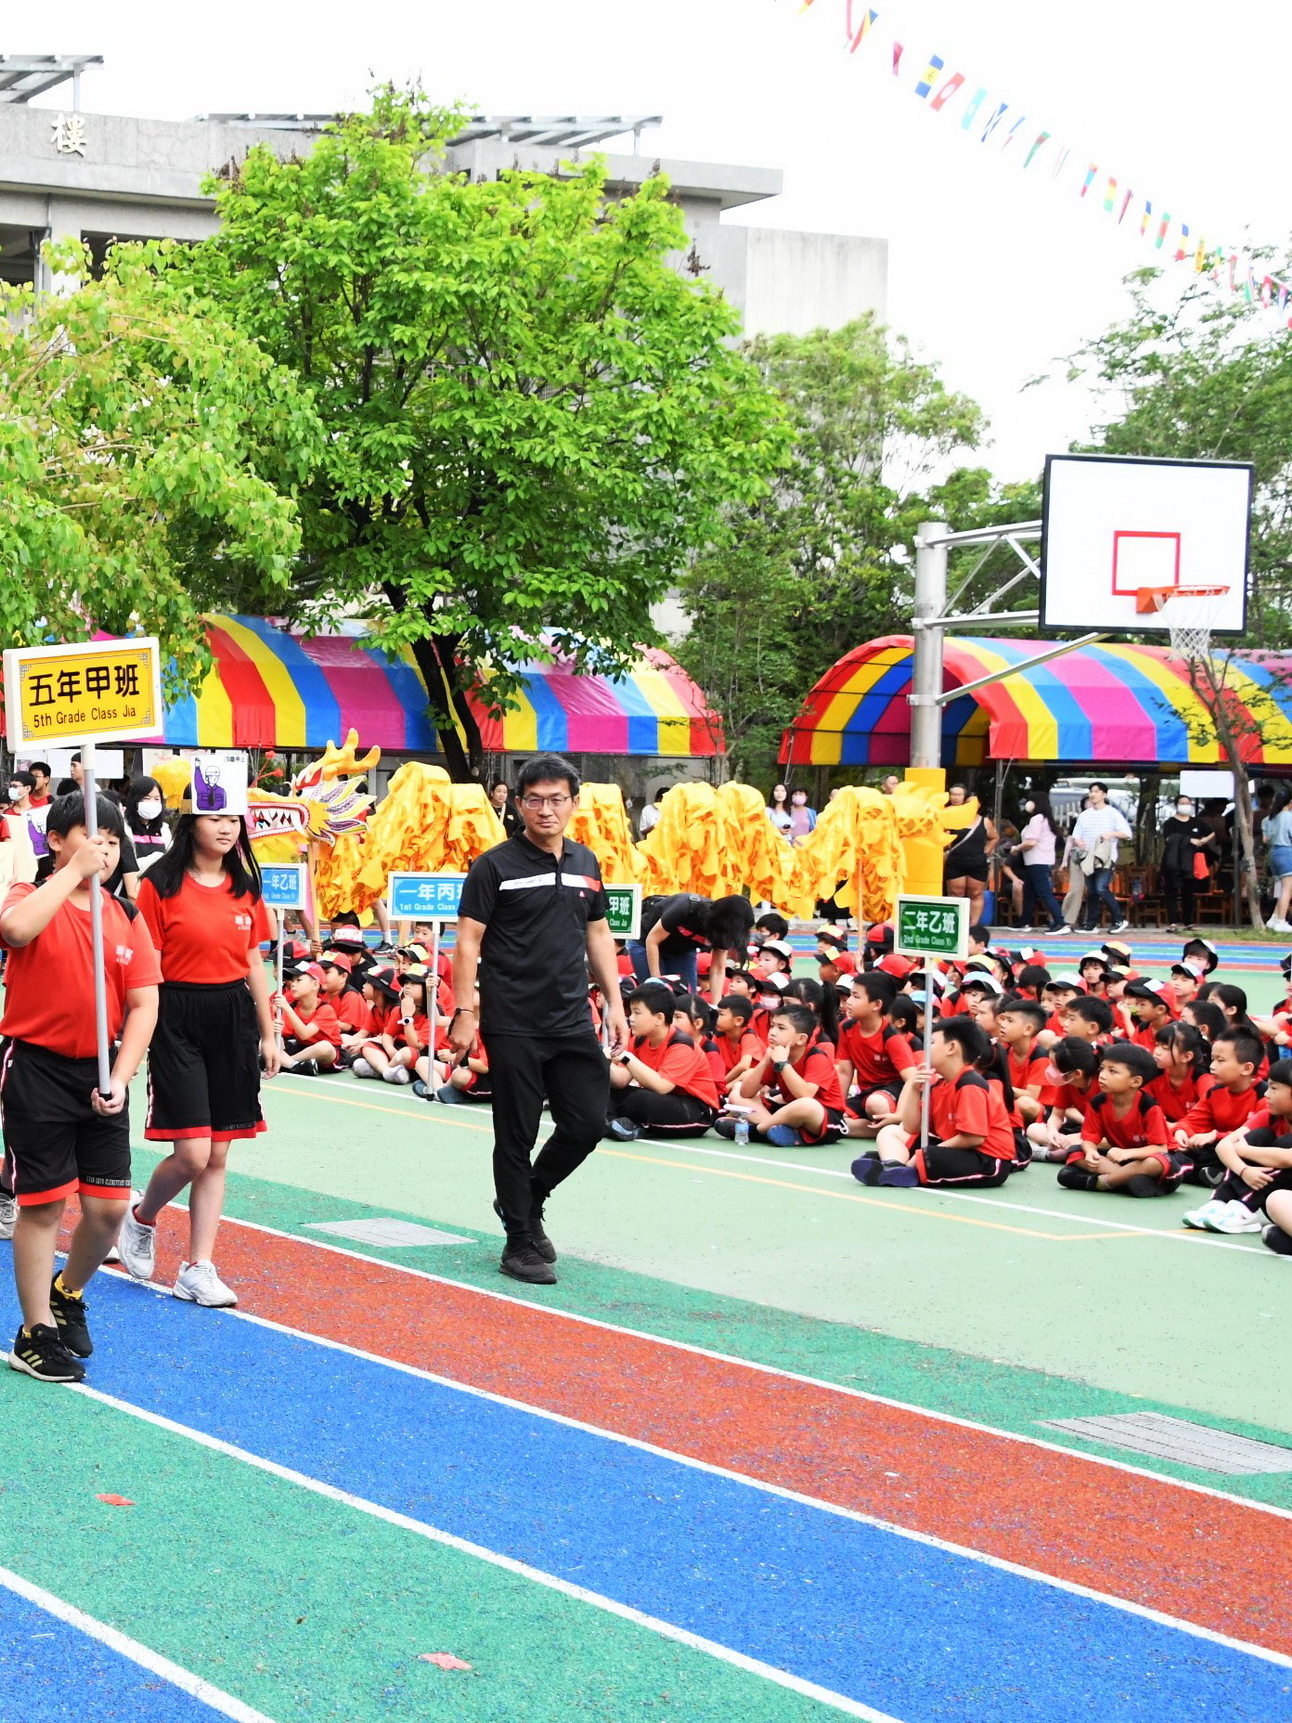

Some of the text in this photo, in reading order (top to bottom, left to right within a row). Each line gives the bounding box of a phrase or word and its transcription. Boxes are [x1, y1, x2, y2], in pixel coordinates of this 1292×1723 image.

[28, 664, 140, 707] 五年甲班
[33, 705, 136, 728] 5th Grade Class Jia
[400, 903, 456, 911] 1st Grade Class
[903, 910, 956, 934] 二年乙班
